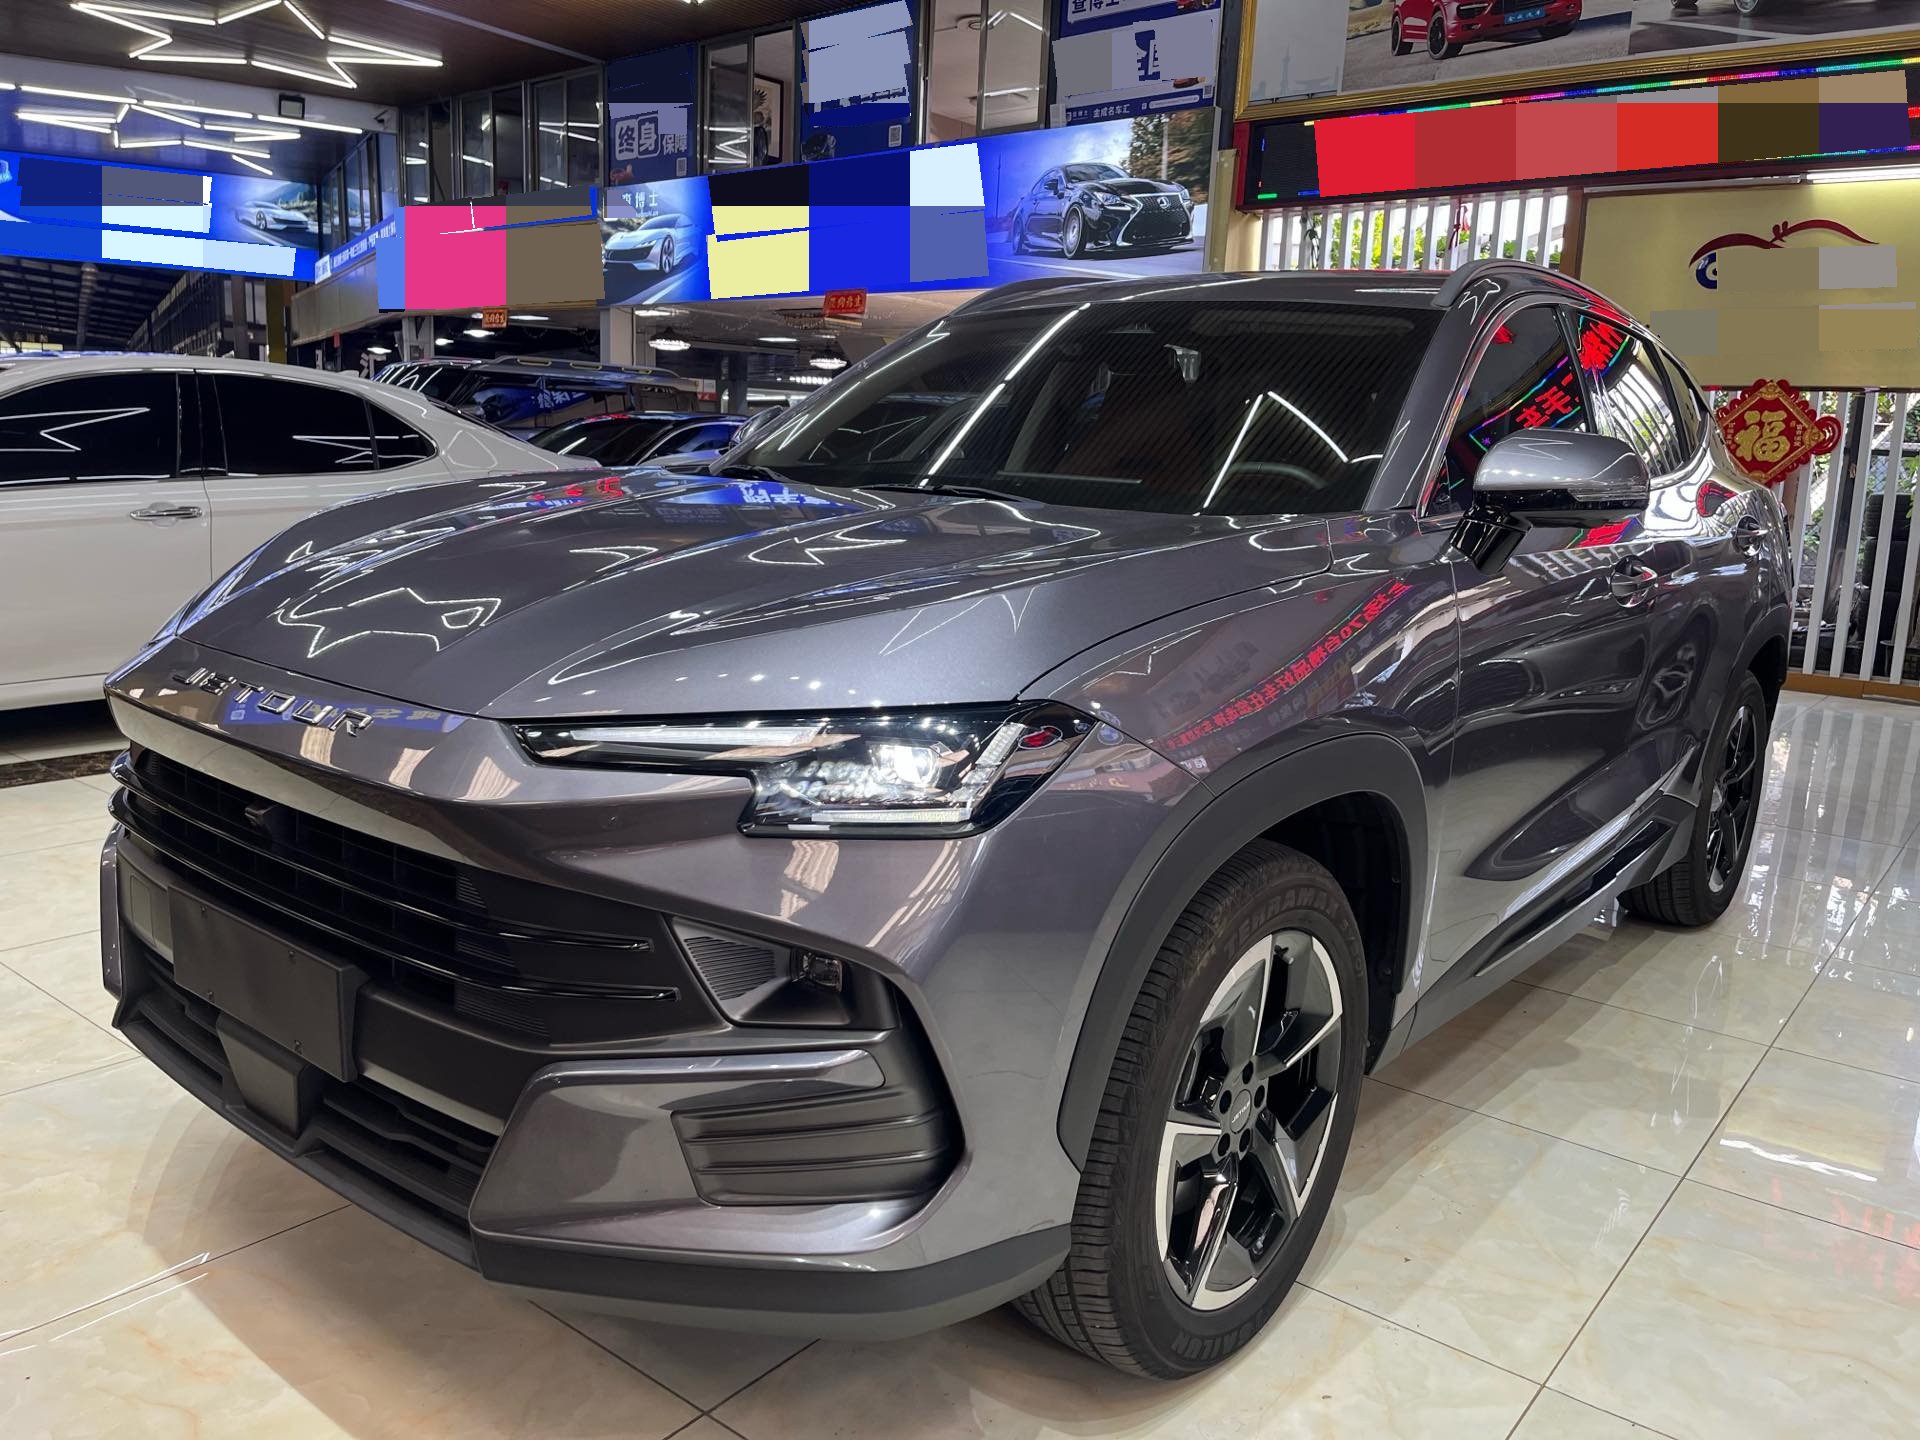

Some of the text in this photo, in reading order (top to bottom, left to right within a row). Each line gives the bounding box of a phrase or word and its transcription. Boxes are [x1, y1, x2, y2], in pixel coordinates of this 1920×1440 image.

[617, 121, 658, 155] 终身
[1734, 410, 1791, 463] 福
[171, 666, 375, 738] JETOUR
